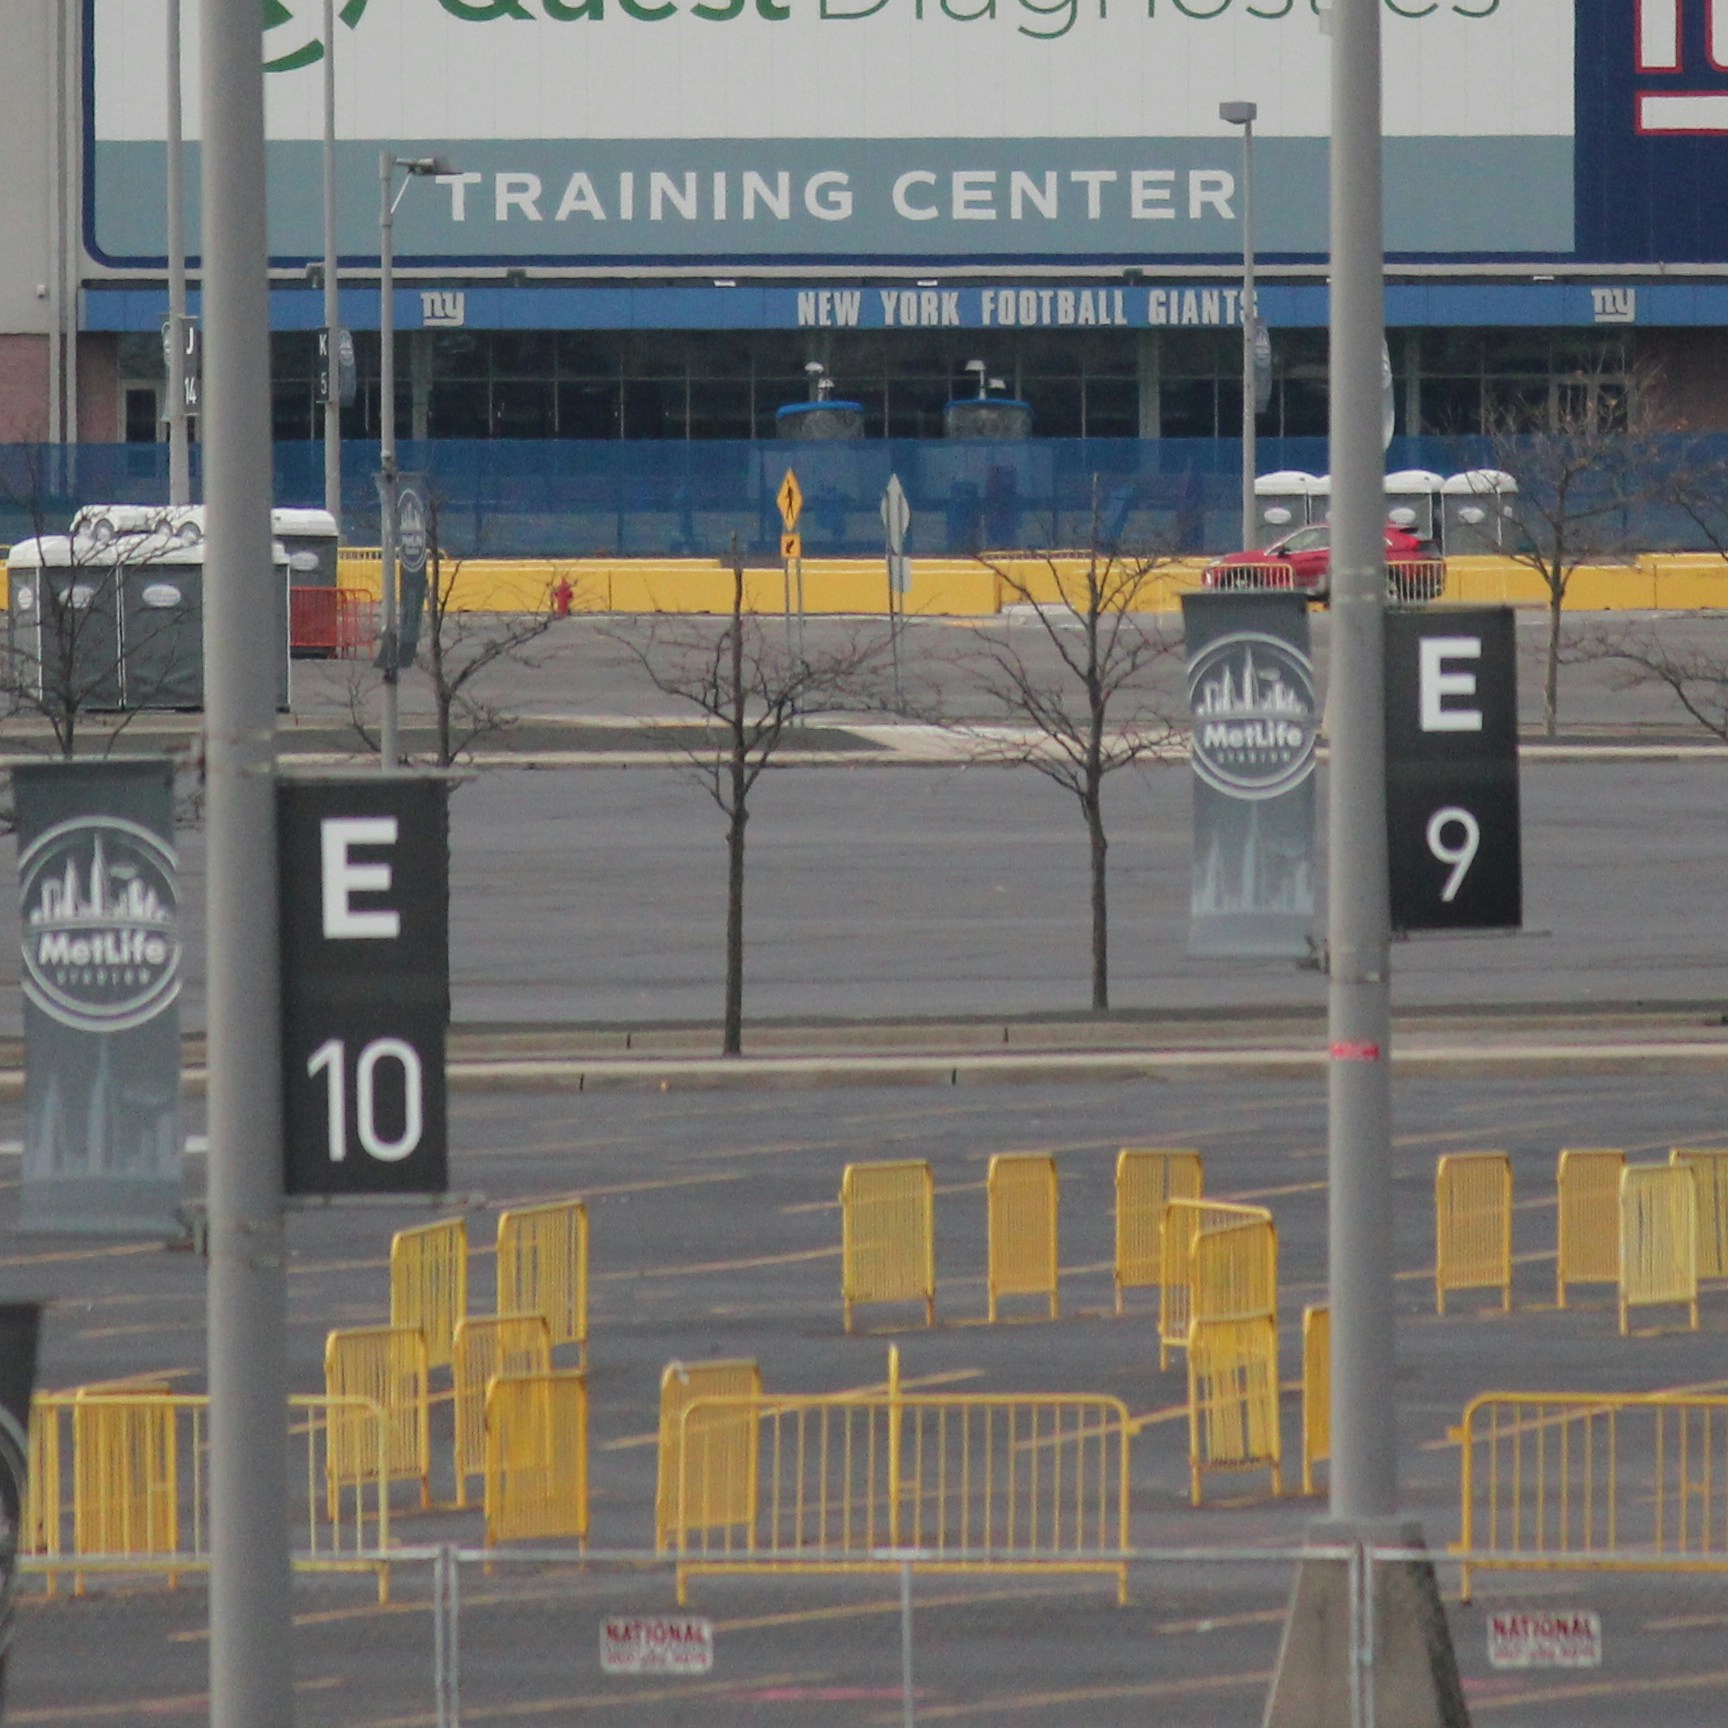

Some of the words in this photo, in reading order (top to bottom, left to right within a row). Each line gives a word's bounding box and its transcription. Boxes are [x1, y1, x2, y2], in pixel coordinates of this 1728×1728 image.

[435, 170, 853, 221] TRAINING
[892, 170, 1236, 221] CENTER
[797, 290, 862, 327] NEW
[879, 290, 960, 326] YORK
[981, 289, 1127, 326] FOOTBALL
[186, 327, 194, 355] J
[319, 333, 327, 356] K
[184, 377, 197, 405] 14
[321, 372, 327, 395] 5
[1419, 636, 1483, 732] E
[1203, 720, 1303, 749] MetLife
[1426, 806, 1481, 903] 9
[321, 816, 401, 939] E
[38, 928, 167, 966] MetLife
[307, 1037, 422, 1162] 10
[606, 1619, 705, 1645] NATIONAL
[1493, 1615, 1595, 1640] NATIONAL
